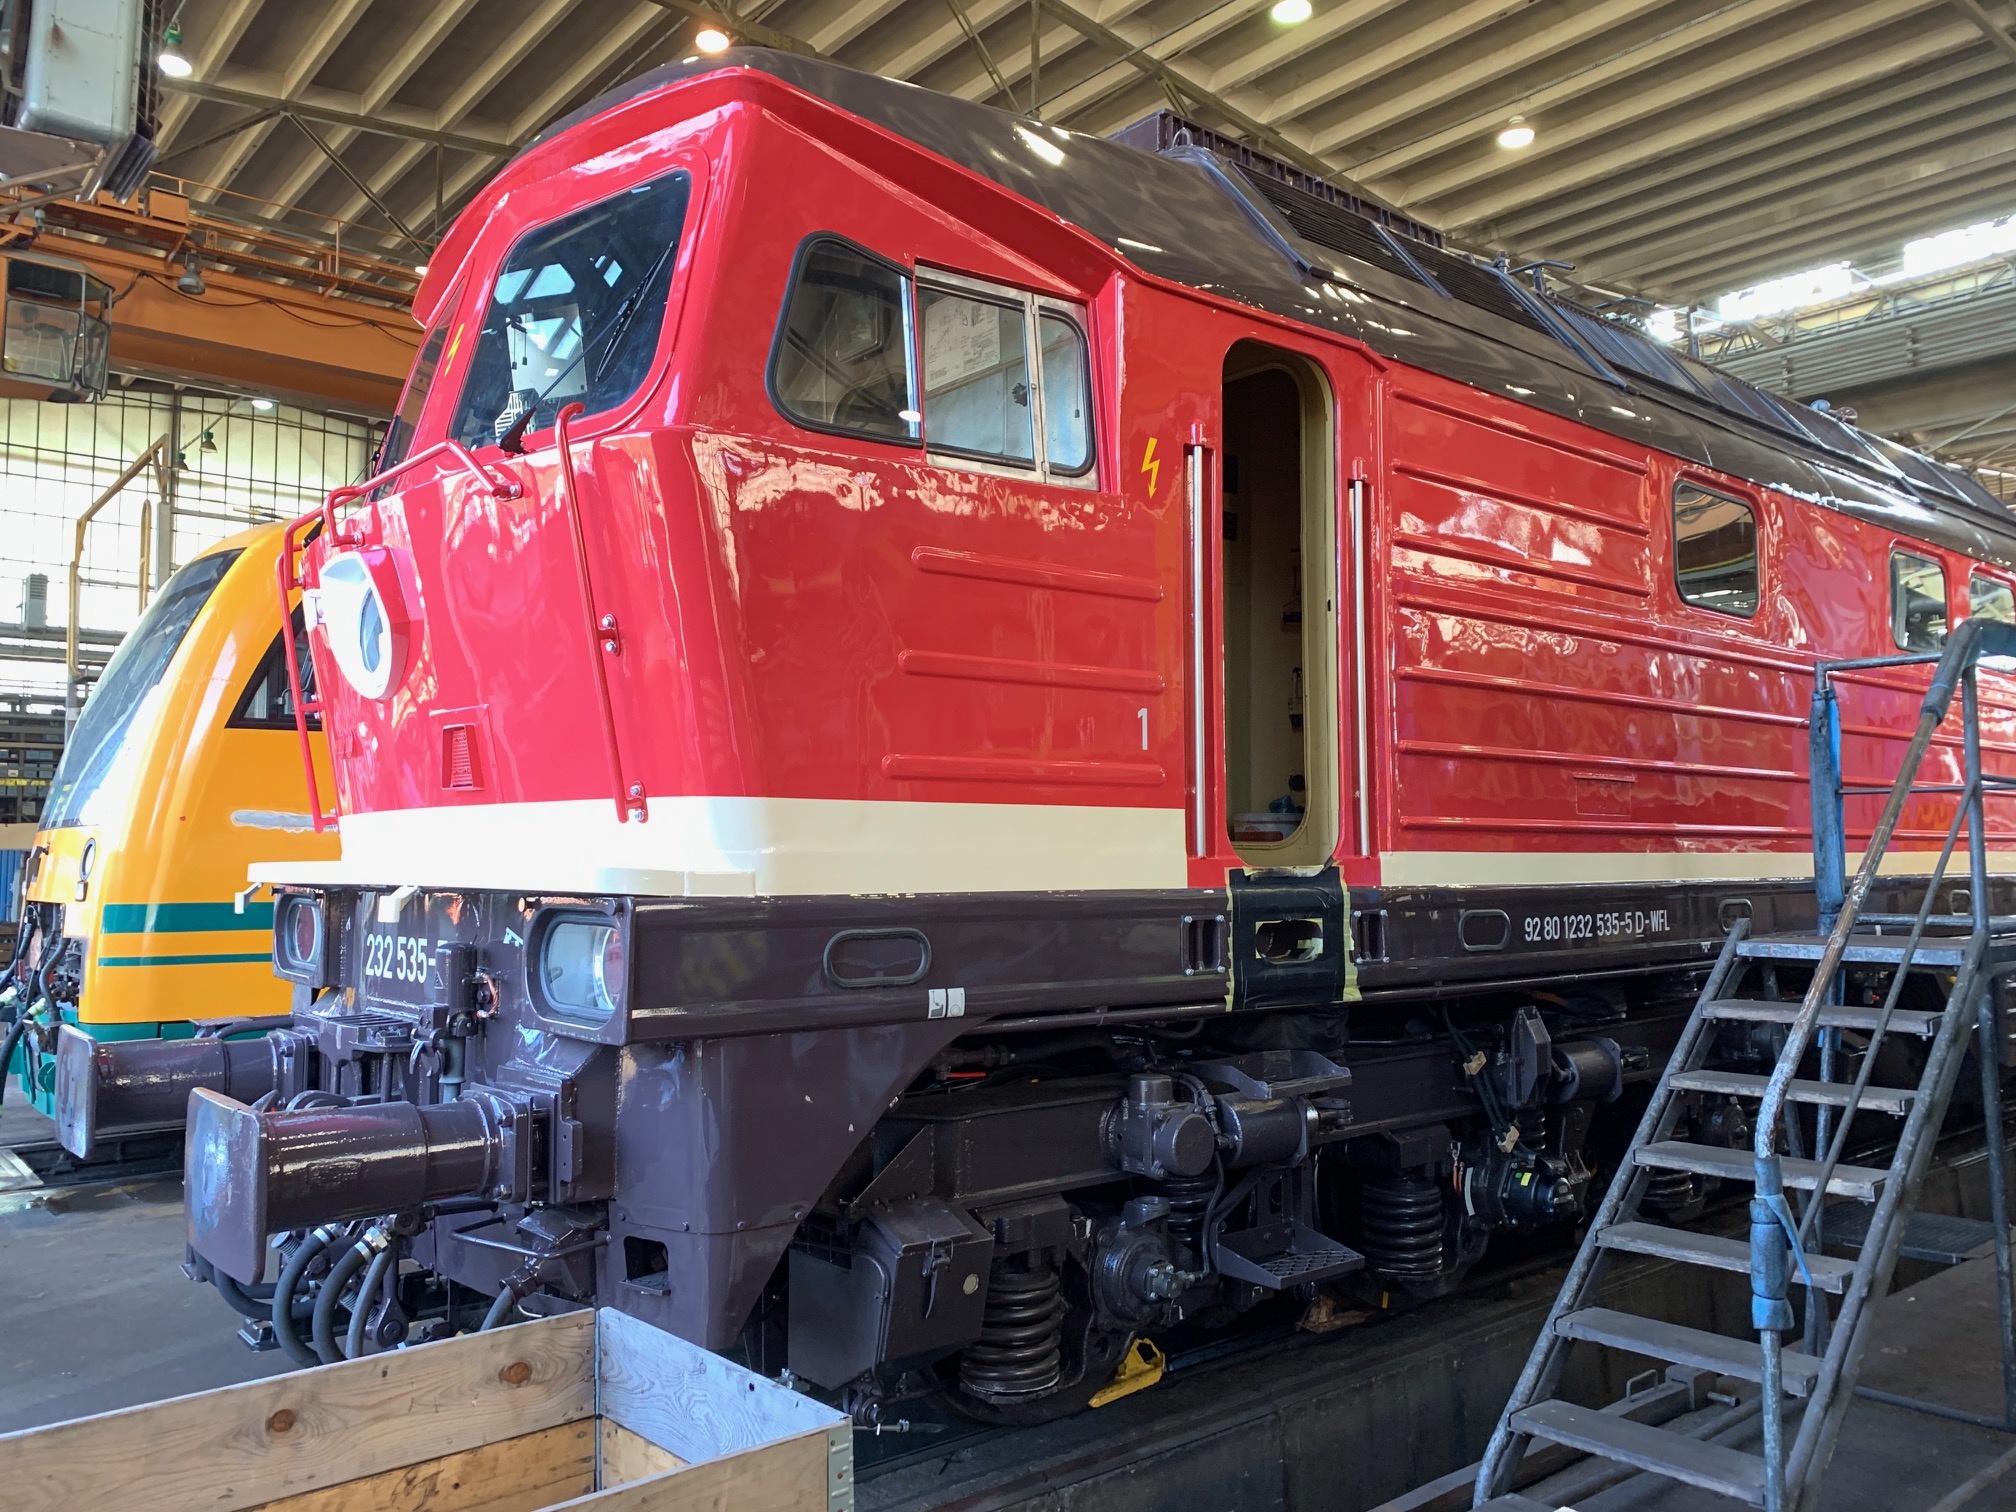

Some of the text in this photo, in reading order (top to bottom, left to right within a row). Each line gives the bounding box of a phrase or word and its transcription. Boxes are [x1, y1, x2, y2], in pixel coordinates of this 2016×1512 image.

[1137, 707, 1148, 751] 1
[1524, 917, 1541, 942] 92
[1545, 916, 1561, 940] 80
[1563, 914, 1593, 939] 1232
[1596, 911, 1632, 936] 535-5
[365, 933, 448, 983] 232 535-
